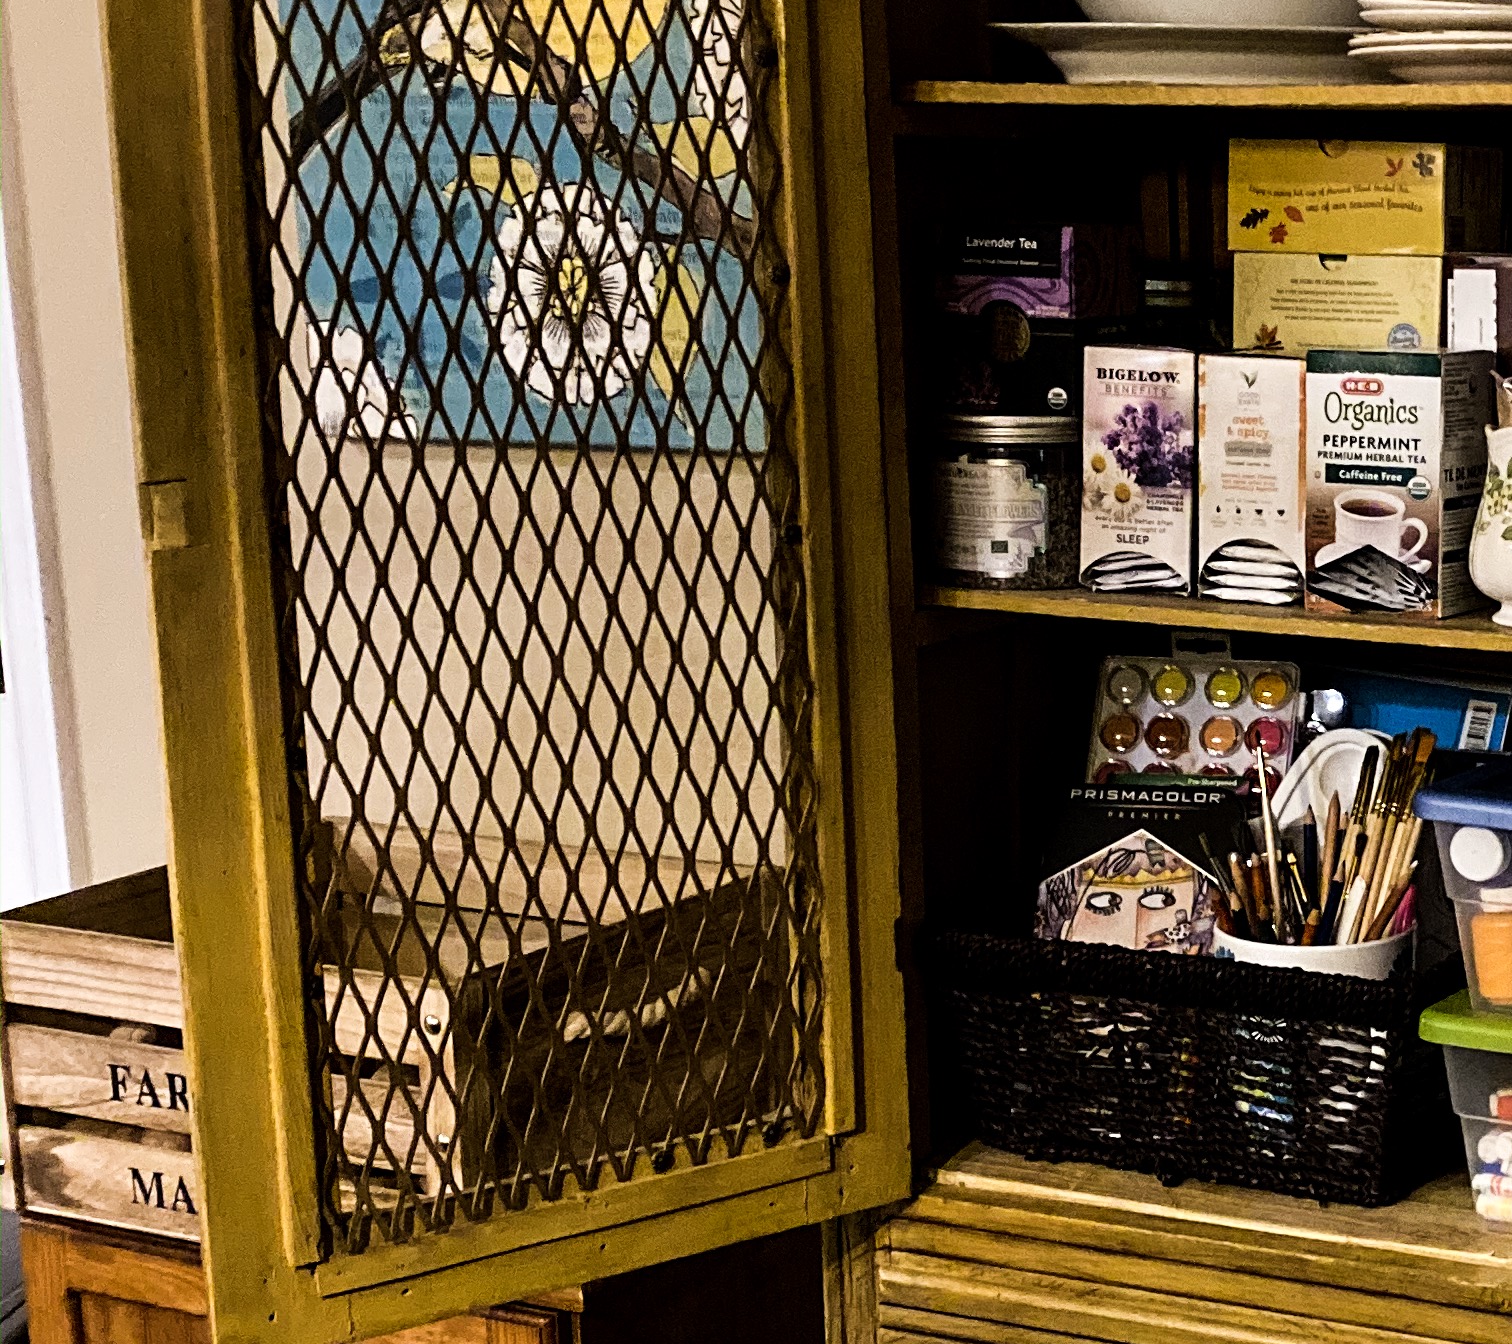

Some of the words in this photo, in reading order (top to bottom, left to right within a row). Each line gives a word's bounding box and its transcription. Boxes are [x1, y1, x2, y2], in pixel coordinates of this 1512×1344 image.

[966, 236, 1016, 249] Lavender
[1018, 237, 1038, 249] Tea
[1095, 367, 1180, 384] BIGELOW
[1105, 383, 1168, 397] BENEFITS
[1324, 391, 1419, 431] Organics
[1323, 434, 1422, 452] PEPPERMINT
[1317, 450, 1363, 461] PREMIUM
[1365, 451, 1404, 463] HERBAL
[1408, 455, 1427, 464] TEA
[1338, 469, 1379, 482] Caffeine
[1381, 471, 1403, 483] Free
[1116, 533, 1150, 545] SLEEP
[1070, 789, 1221, 804] PRISMACOLOR
